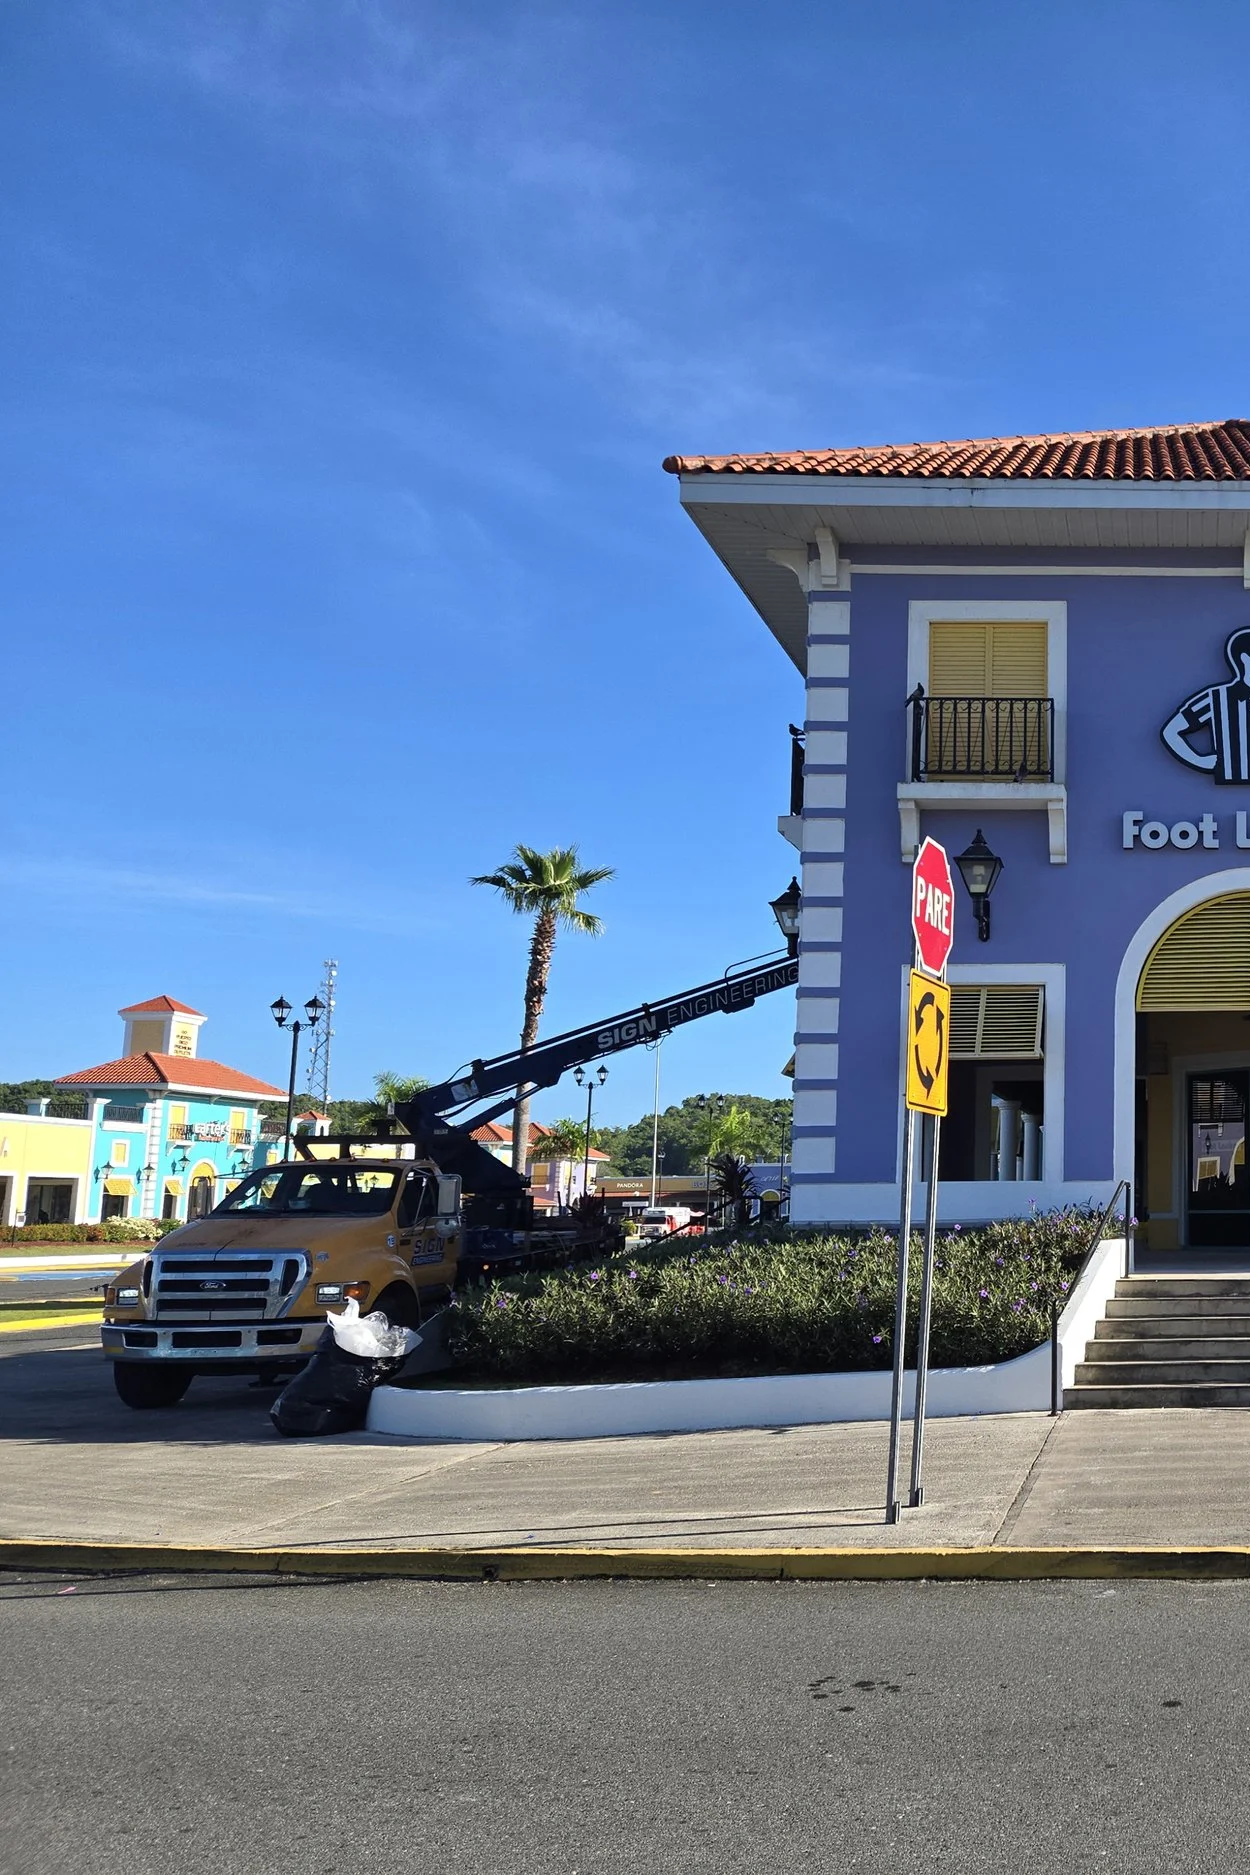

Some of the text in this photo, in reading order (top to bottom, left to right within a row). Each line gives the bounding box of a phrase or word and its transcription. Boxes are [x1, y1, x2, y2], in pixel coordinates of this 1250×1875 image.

[1122, 810, 1220, 850] Foot
[916, 875, 951, 937] PARE
[597, 965, 799, 1050] SIGN ENGINEERING
[414, 1237, 445, 1255] SIGN
